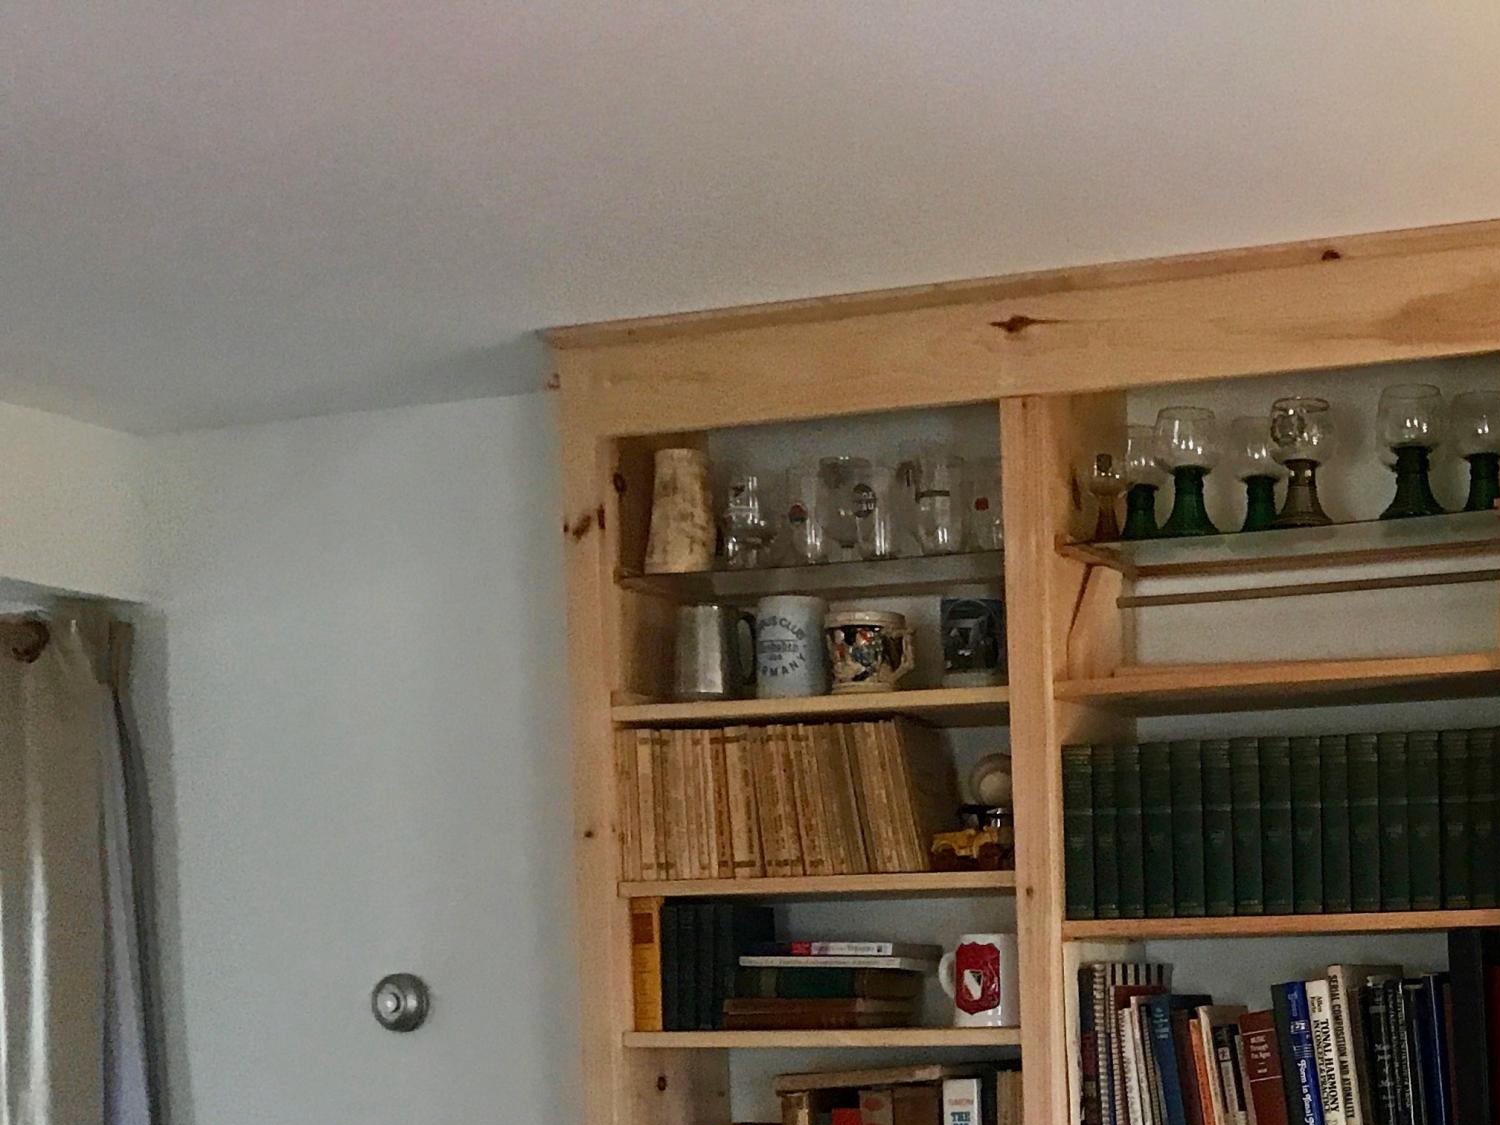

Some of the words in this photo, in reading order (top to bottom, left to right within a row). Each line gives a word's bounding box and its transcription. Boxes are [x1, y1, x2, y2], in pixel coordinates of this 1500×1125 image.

[1329, 975, 1342, 1001] SERIAL
[1313, 1020, 1320, 1029] IN
[1332, 1004, 1348, 1057] COMPOSITION
[1314, 1030, 1325, 1066] CONCEPT
[1298, 1059, 1307, 1083] Form
[1319, 1019, 1333, 1053] TONAL
[1326, 1058, 1340, 1112] HARMONY
[1341, 1060, 1350, 1075] AND
[1320, 1075, 1331, 1113] PRACTICE
[1343, 1078, 1355, 1118] ATONALITY
[950, 1111, 971, 1122] THE
